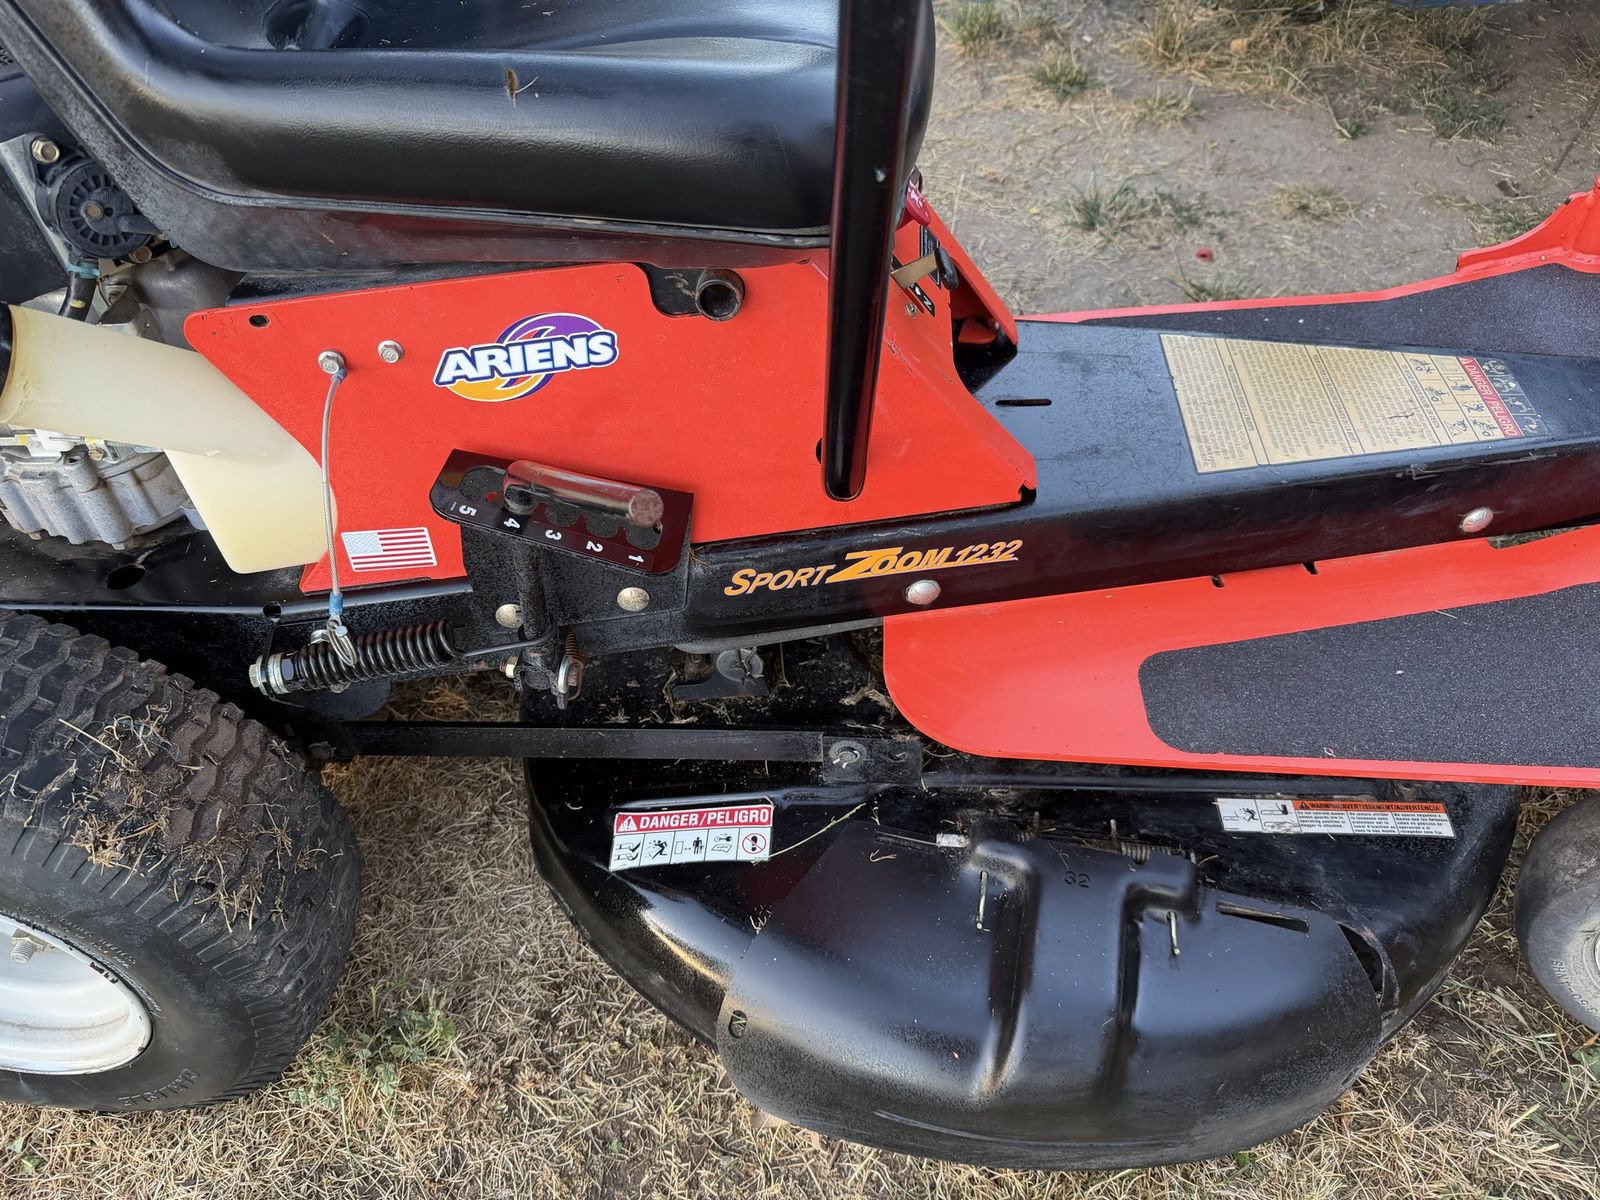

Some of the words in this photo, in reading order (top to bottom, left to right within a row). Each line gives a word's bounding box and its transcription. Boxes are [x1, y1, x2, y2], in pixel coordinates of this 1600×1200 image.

[436, 331, 616, 385] ARIENS
[1466, 365, 1492, 395] DANGER
[1487, 401, 1518, 436] PELIGRO
[458, 505, 477, 517] 5
[503, 517, 520, 531] 4
[545, 529, 562, 541] 3
[586, 540, 603, 553] 2
[628, 554, 645, 564] 1
[723, 564, 837, 597] SPORT
[825, 546, 954, 584] ZOOM
[954, 539, 1023, 566] 1232
[1063, 870, 1090, 888] 32
